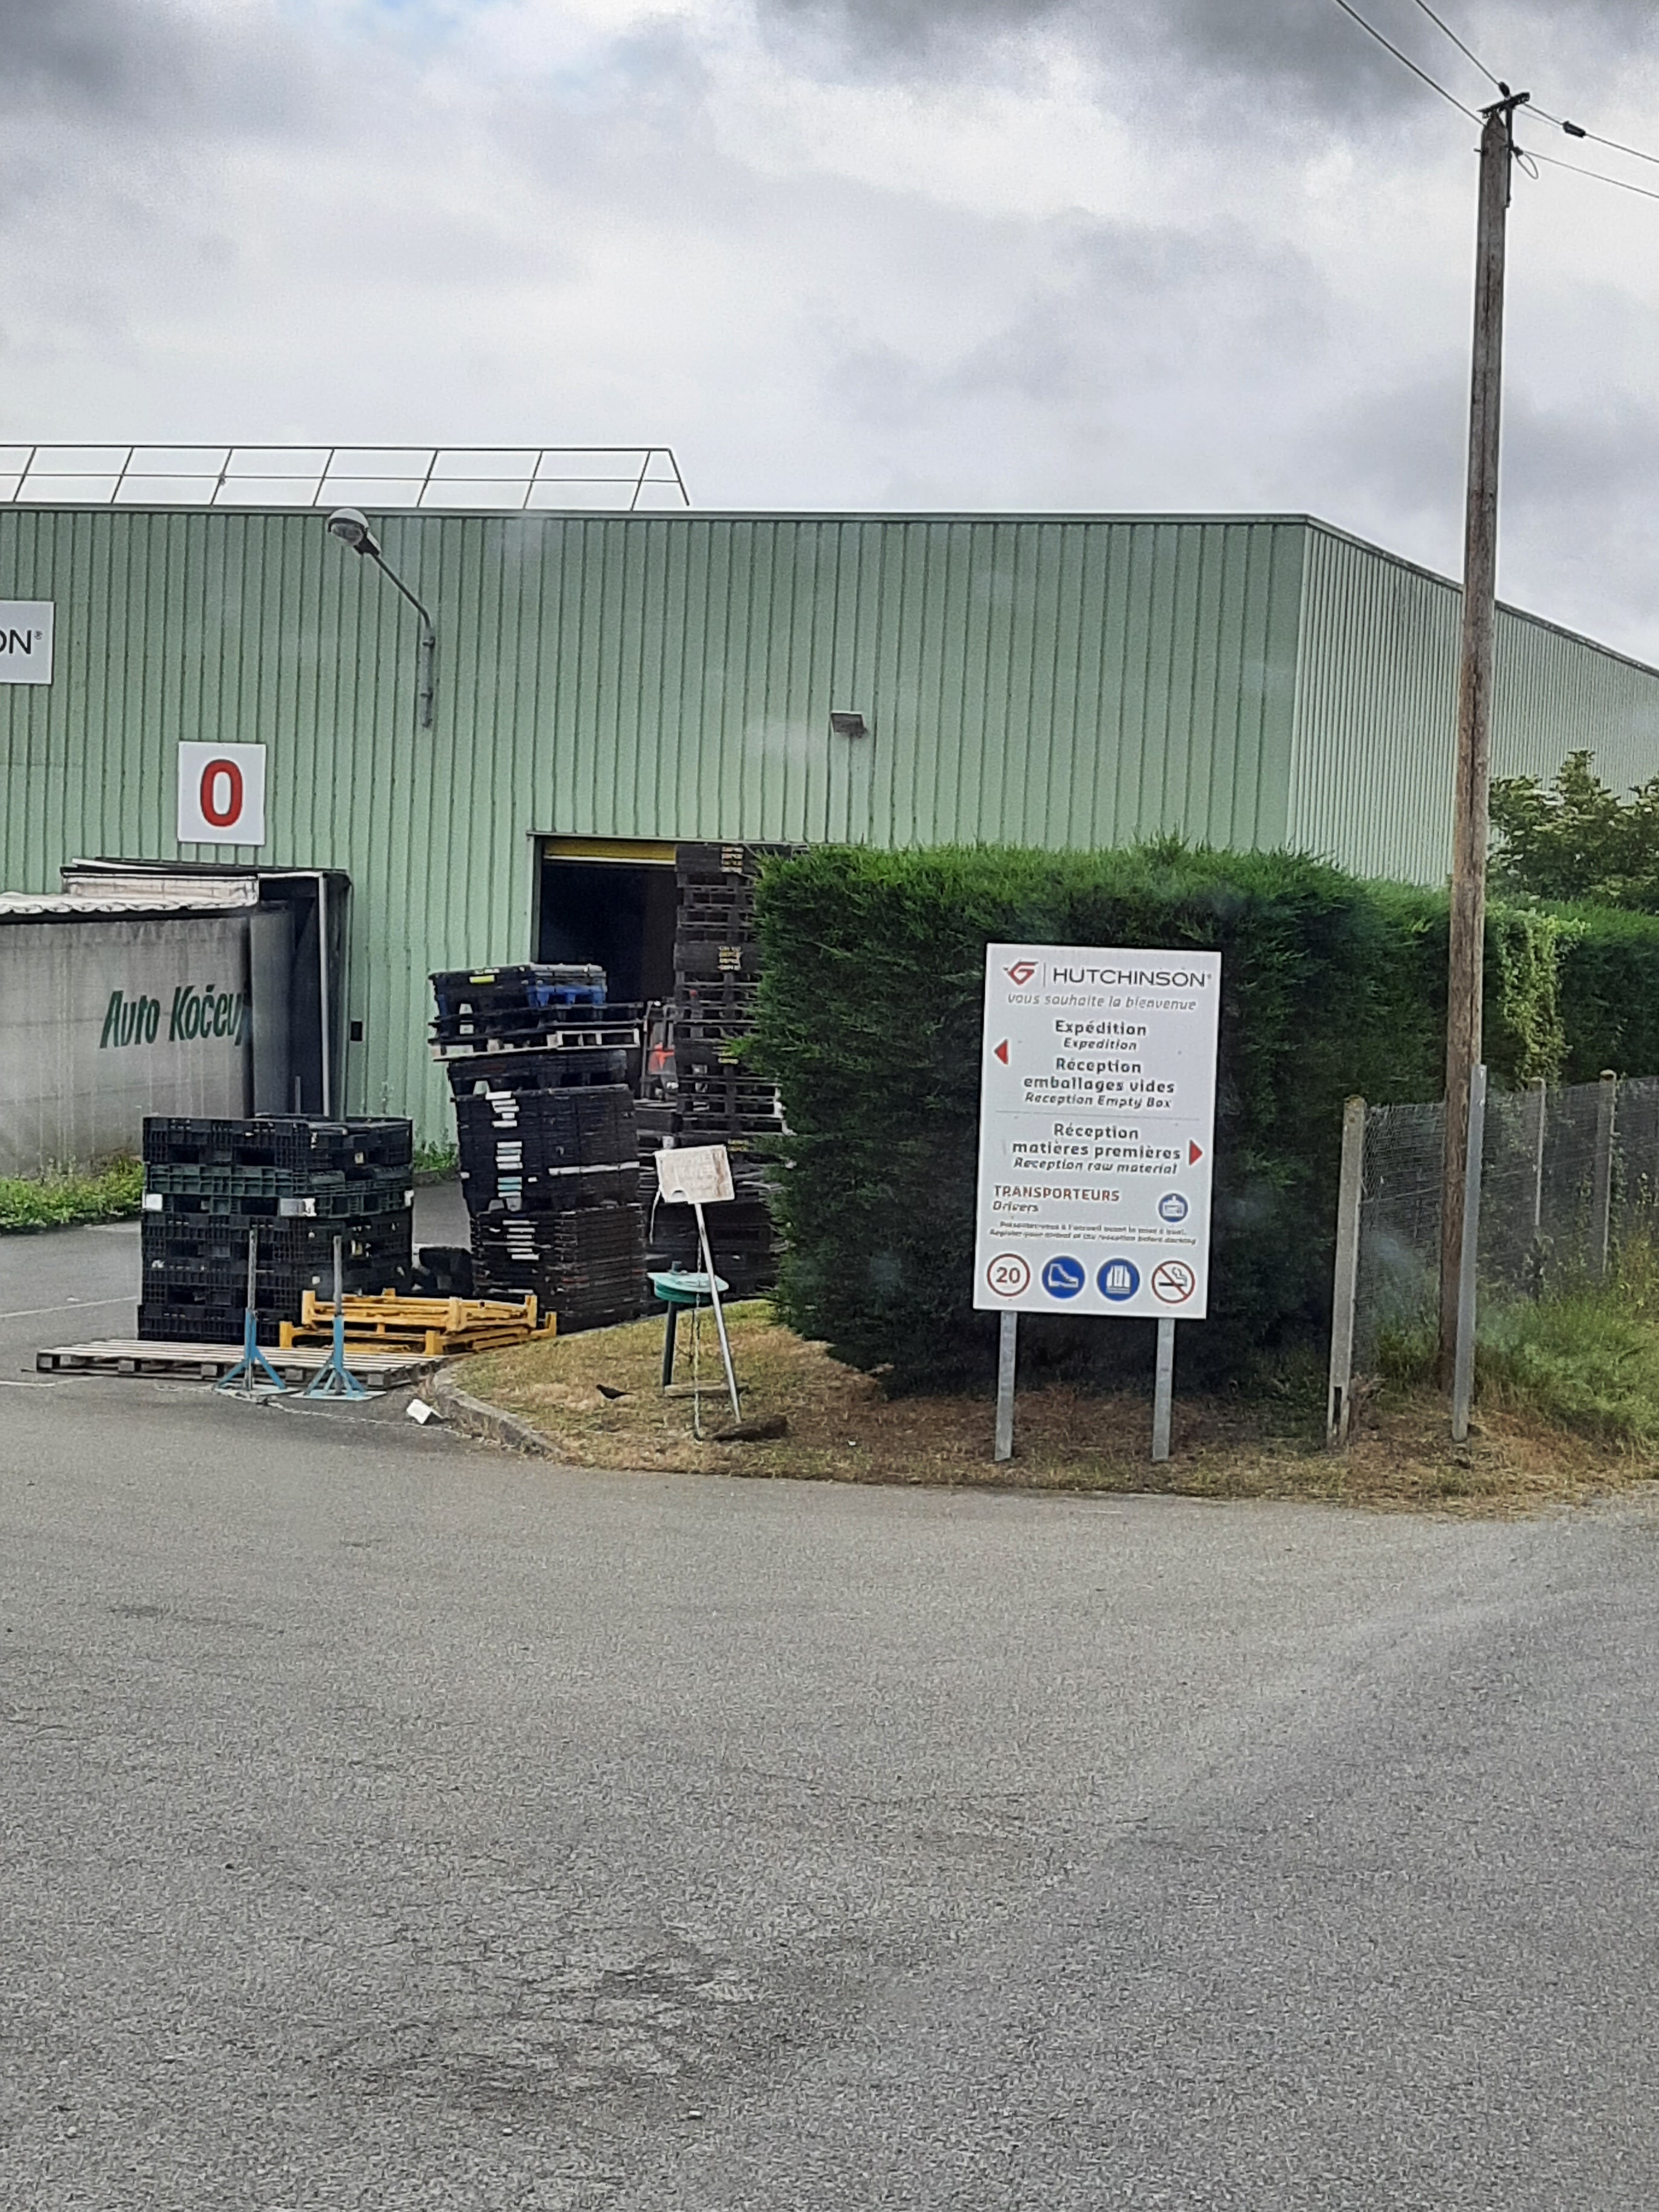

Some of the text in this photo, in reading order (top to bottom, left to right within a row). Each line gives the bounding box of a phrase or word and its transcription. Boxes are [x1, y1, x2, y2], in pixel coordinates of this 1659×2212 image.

[199, 759, 243, 827] 0
[1053, 968, 1206, 987] HUTCHINSON
[1008, 994, 1196, 1010] vous souhaite la bienvenue
[100, 990, 161, 1049] Auto
[1056, 1020, 1146, 1036] Expédition
[1064, 1038, 1137, 1051] Expedition
[1056, 1058, 1141, 1074] Réception
[1024, 1077, 1174, 1093] emballages vides
[1025, 1092, 1171, 1109] Reception Empty Box
[1054, 1123, 1138, 1140] Réception
[1013, 1141, 1181, 1160] matières premières
[1014, 1157, 1177, 1174] Reception raw material
[994, 1185, 1120, 1201] TRANSPORTEURS
[996, 1266, 1020, 1283] 20
